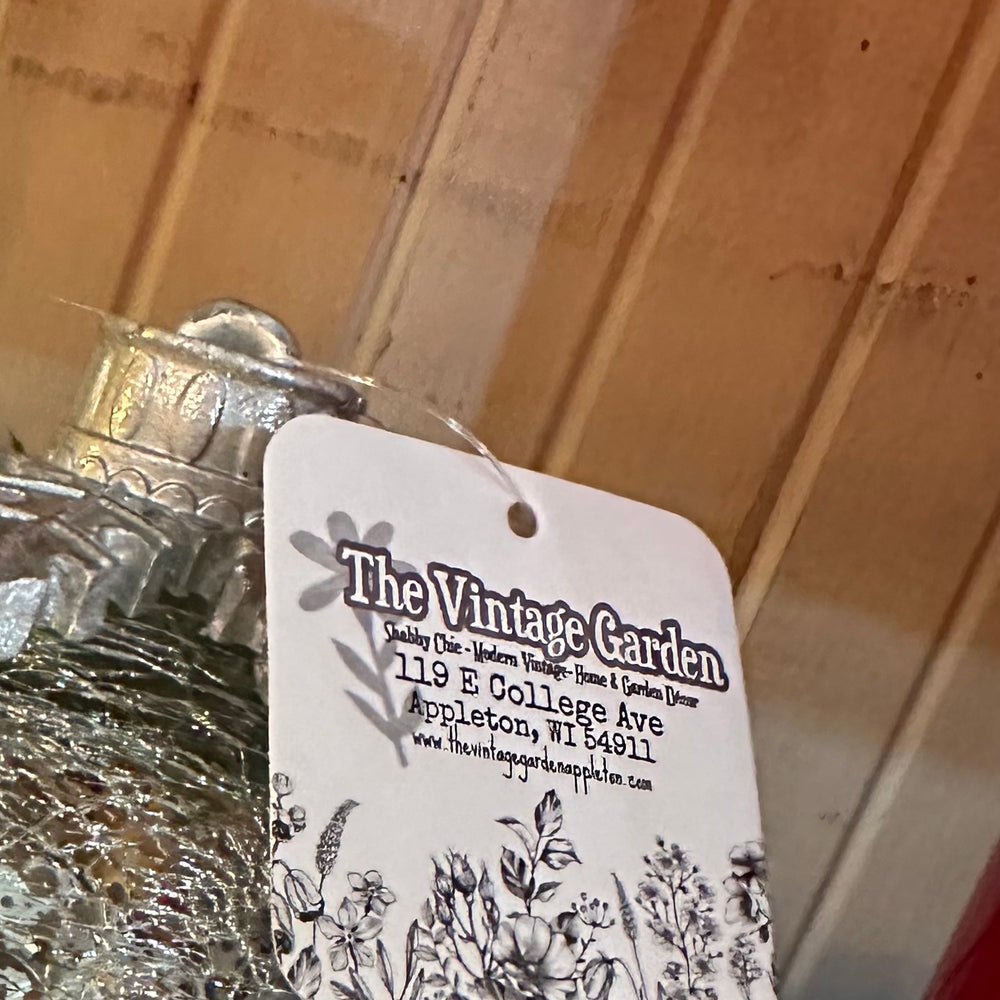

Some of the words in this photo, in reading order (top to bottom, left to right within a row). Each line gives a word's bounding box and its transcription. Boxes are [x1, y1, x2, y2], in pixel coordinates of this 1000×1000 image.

[339, 543, 427, 617] The
[431, 566, 587, 659] Vintage
[592, 606, 726, 689] Garden
[384, 621, 430, 650] Shabby
[473, 641, 518, 667] Modern
[395, 652, 449, 688] 119
[460, 666, 478, 695] E
[490, 674, 607, 727] College
[616, 702, 664, 736] Ave
[408, 690, 538, 743] Appleton,
[548, 719, 577, 747] WI
[584, 727, 657, 763] 54911
[412, 724, 653, 795] www.thevintagegardenappleton.com
